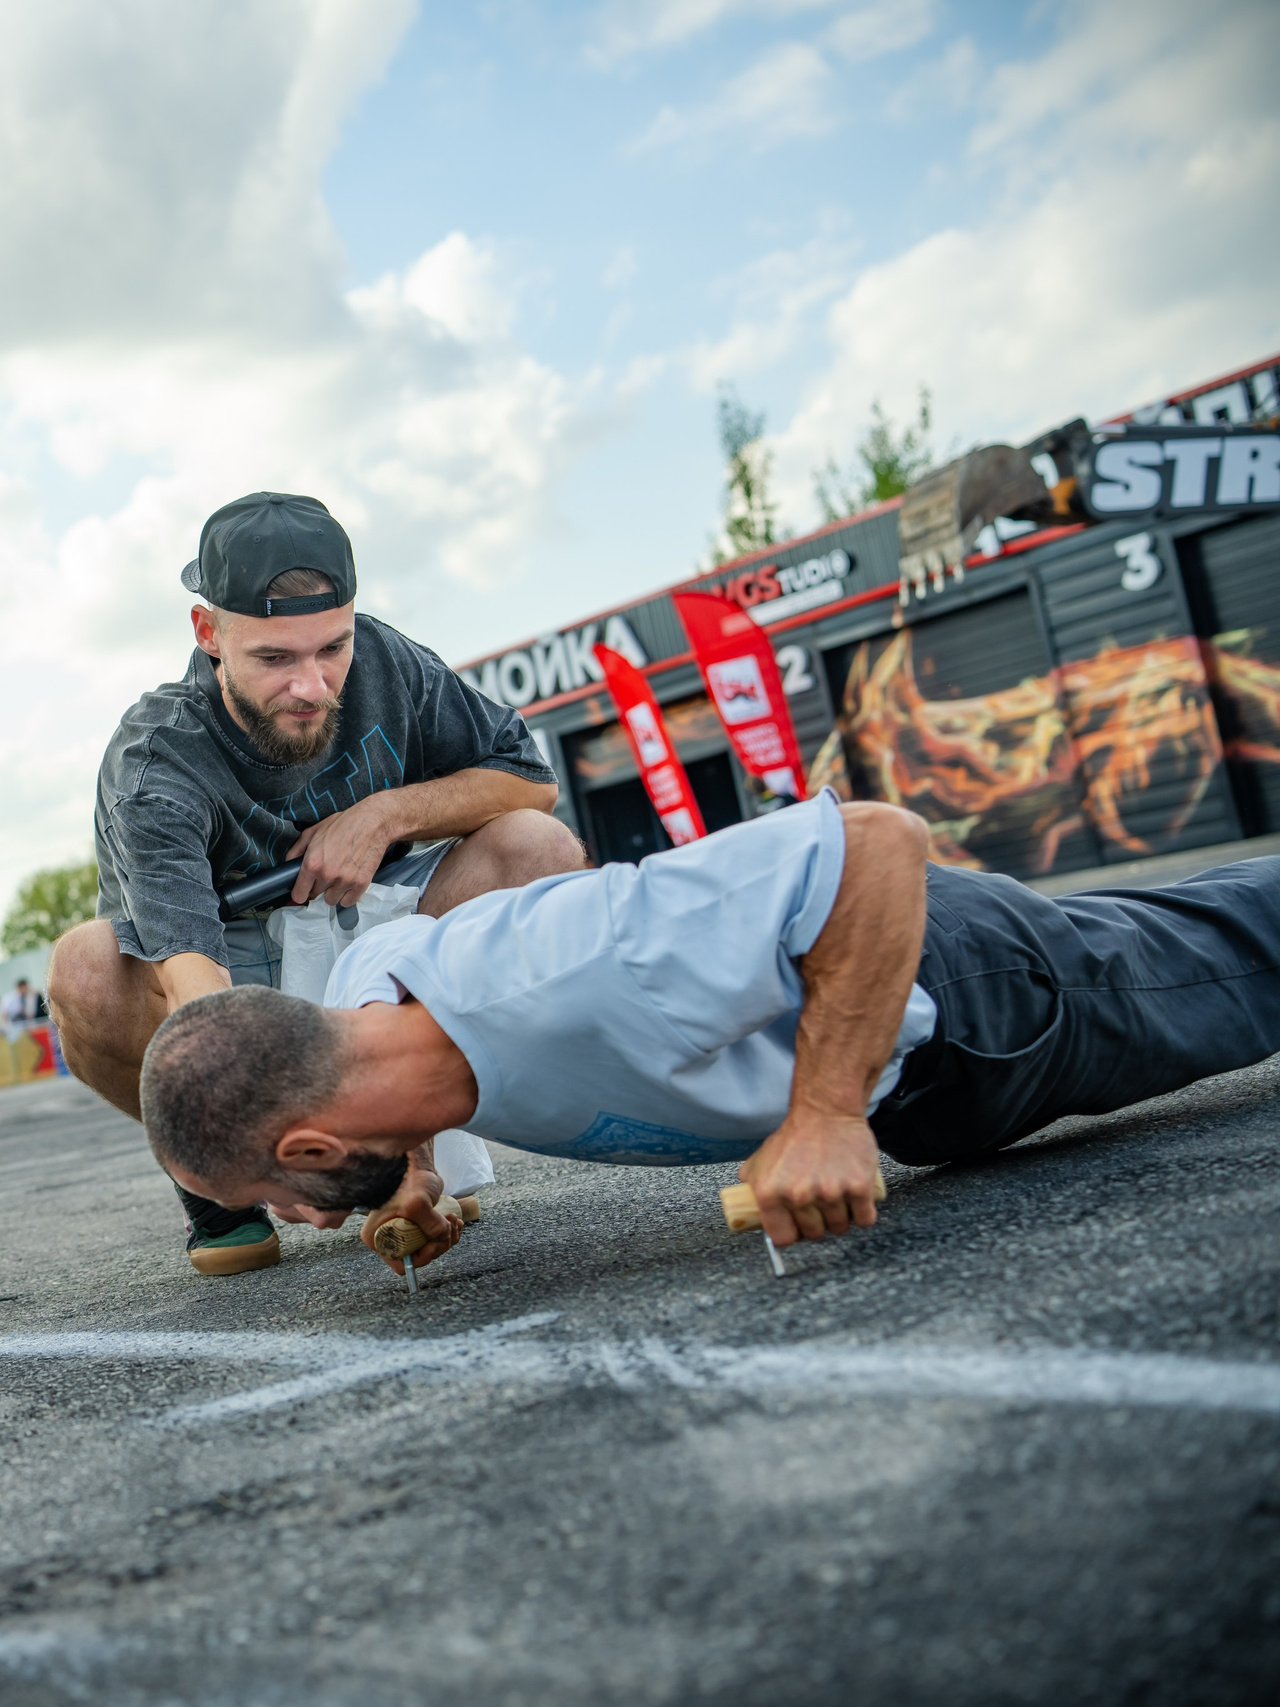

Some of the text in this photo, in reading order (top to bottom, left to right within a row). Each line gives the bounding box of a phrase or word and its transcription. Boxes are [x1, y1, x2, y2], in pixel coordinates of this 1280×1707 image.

[1091, 434, 1280, 512] STR
[1114, 532, 1162, 591] 3
[775, 645, 815, 696] 2
